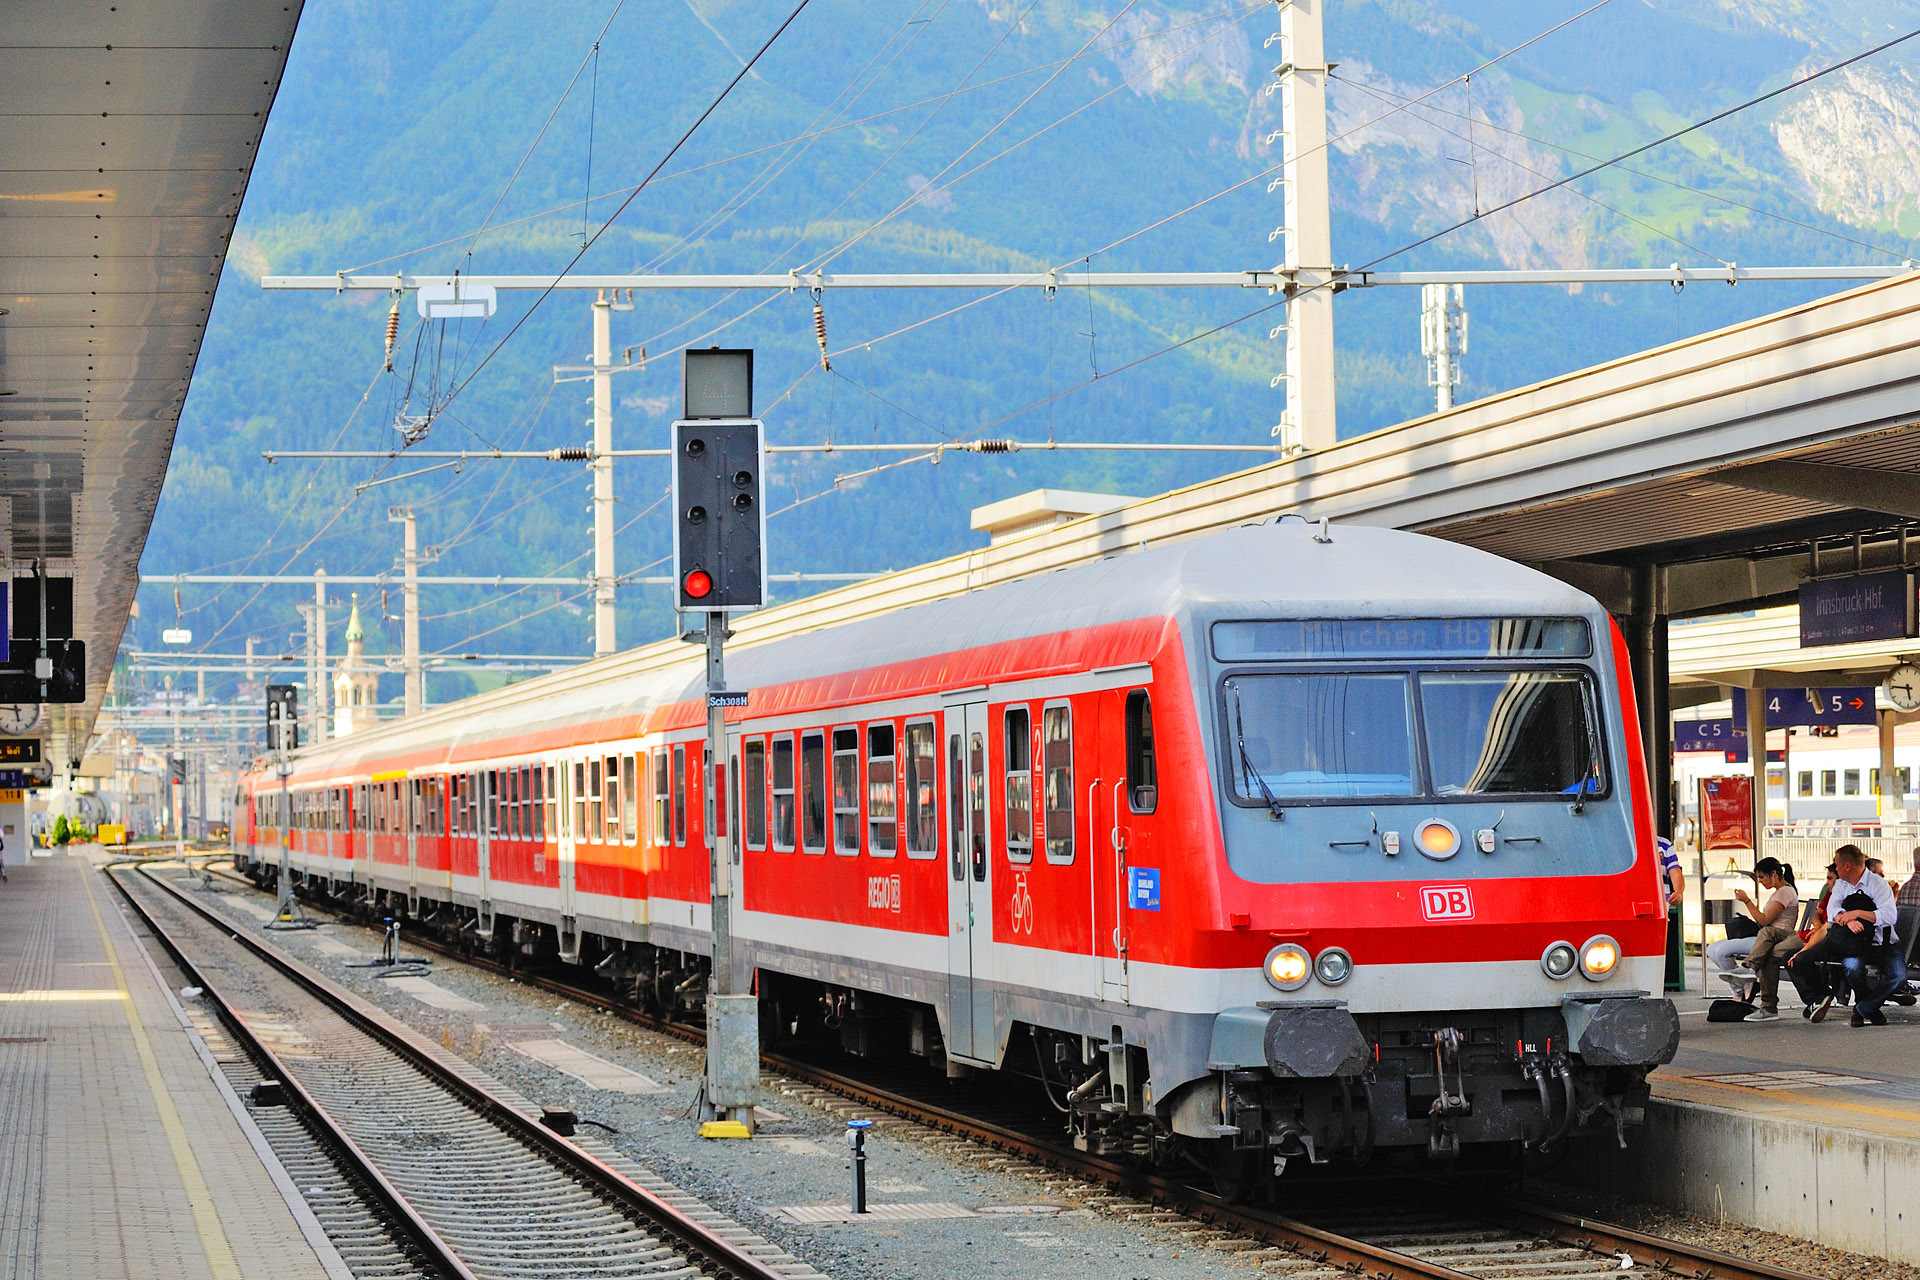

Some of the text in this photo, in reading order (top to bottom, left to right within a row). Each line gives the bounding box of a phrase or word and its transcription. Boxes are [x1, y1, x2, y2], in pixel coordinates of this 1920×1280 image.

[709, 696, 748, 707] Sch308H
[1768, 695, 1843, 713] 4 5
[1698, 724, 1708, 737] C
[1712, 724, 1722, 737] 5
[27, 745, 33, 757] 1
[897, 741, 904, 779] 2
[1034, 728, 1042, 772] 2
[868, 876, 890, 909] REGIO
[1426, 890, 1468, 916] DB
